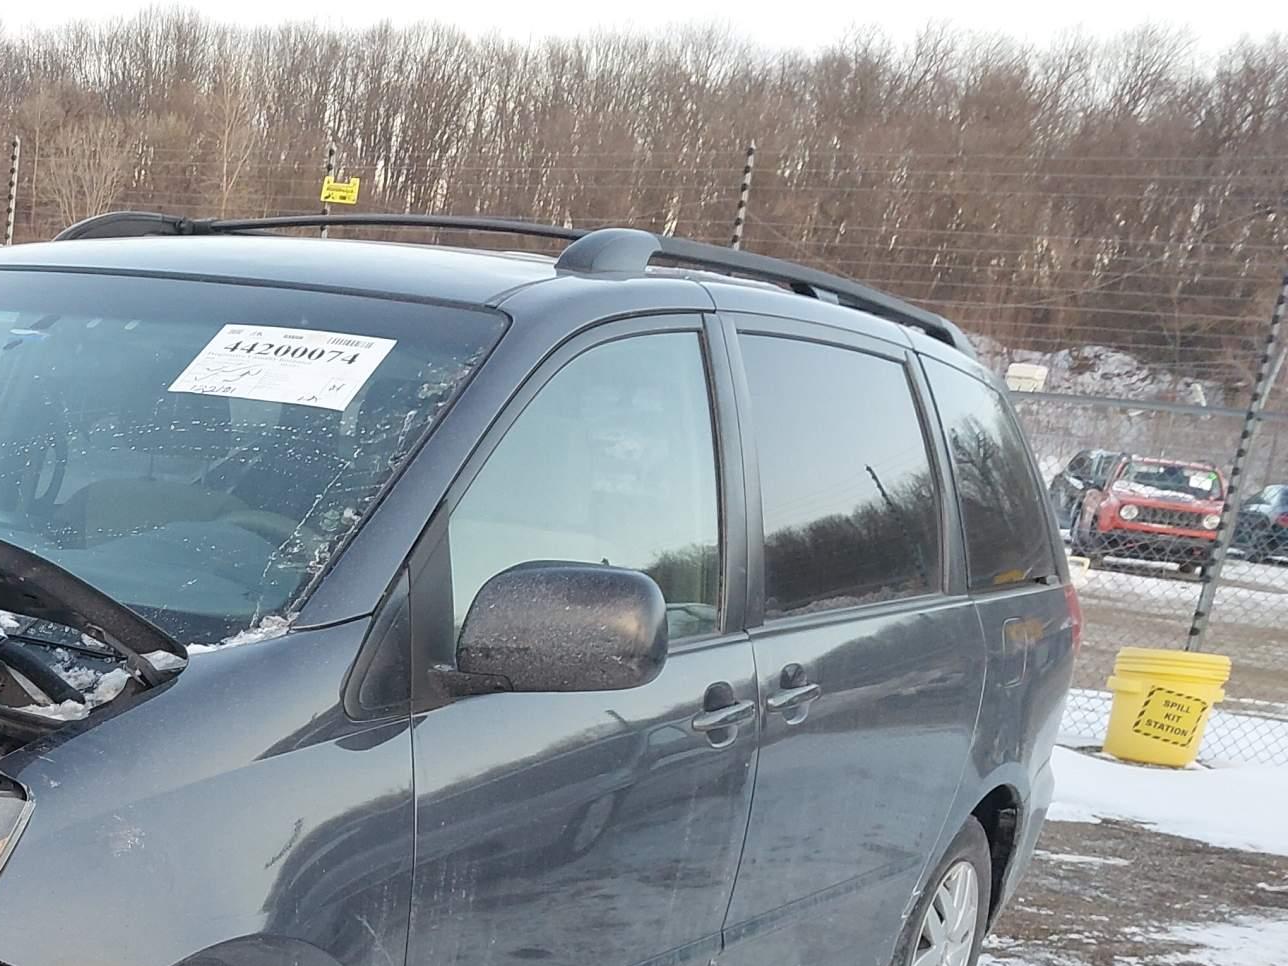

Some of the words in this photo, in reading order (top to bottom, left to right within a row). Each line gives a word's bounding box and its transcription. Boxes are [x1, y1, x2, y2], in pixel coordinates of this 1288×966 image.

[223, 340, 361, 365] 44200074
[1163, 700, 1191, 713] SPILL
[1164, 712, 1182, 723] KIT
[1145, 719, 1188, 737] STATION
